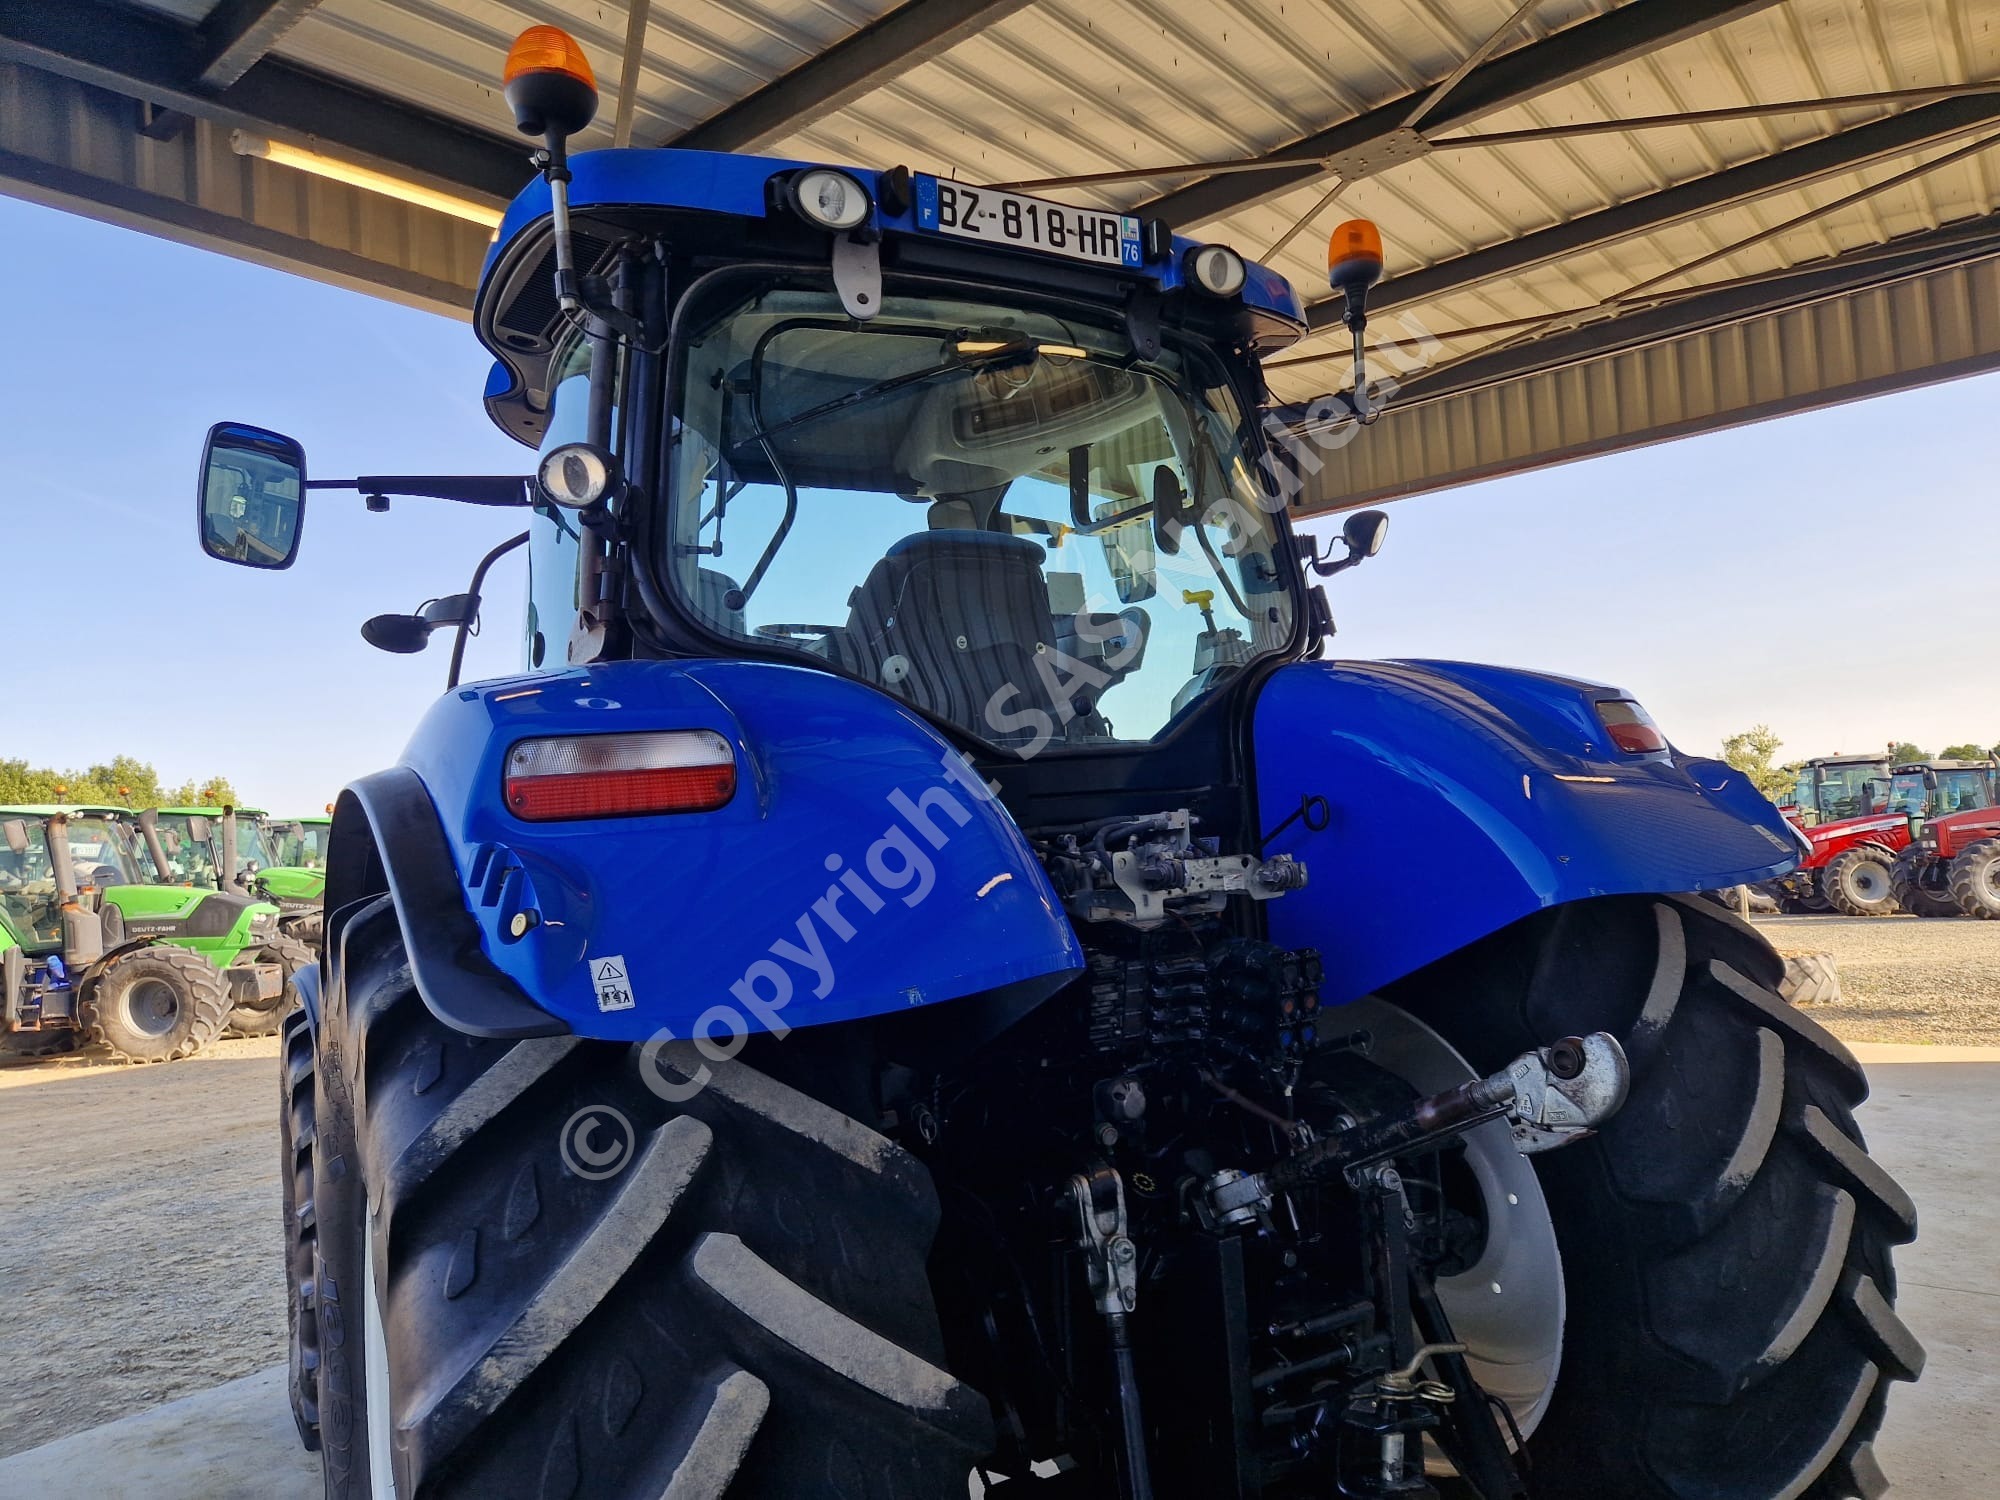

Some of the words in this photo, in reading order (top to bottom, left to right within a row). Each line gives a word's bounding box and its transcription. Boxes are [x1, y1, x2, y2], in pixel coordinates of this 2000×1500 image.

[924, 208, 932, 220] F
[937, 184, 1119, 258] BZ-818-HR
[1123, 243, 1139, 262] 76
[132, 925, 176, 933] DEUTZ-FAHR
